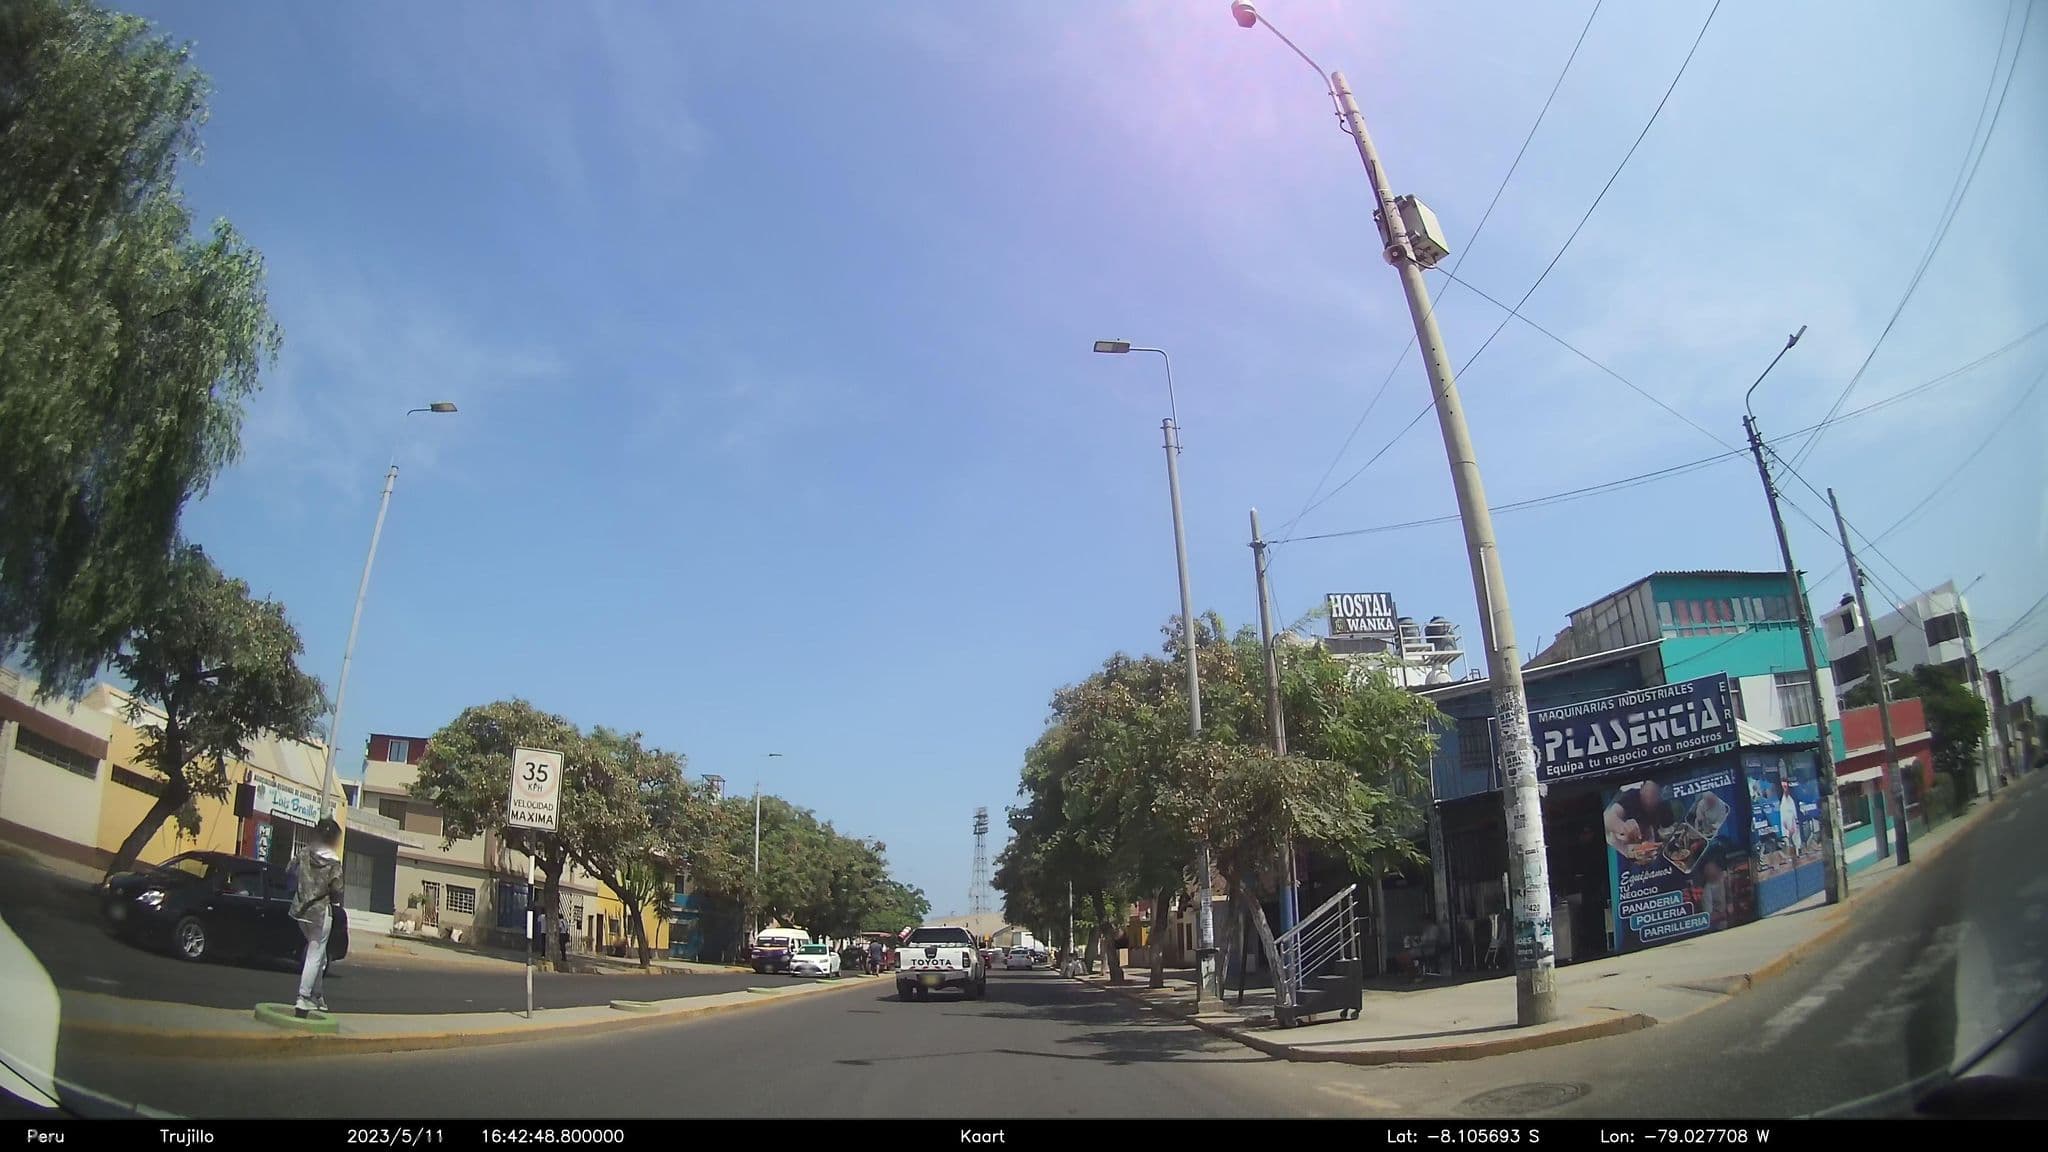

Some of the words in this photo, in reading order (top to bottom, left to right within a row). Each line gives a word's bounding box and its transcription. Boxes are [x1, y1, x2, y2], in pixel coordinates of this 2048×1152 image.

[1329, 593, 1391, 617] HOSTAL
[1346, 618, 1395, 631] WANKA
[1538, 699, 1615, 723] MAQUINARIAS
[1618, 683, 1694, 707] INDUSTRIALES
[1546, 761, 1585, 777] Equipa
[1588, 757, 1601, 769] tu
[1605, 747, 1648, 765] negocio
[1652, 742, 1672, 755] con
[1676, 732, 1722, 750] nosotros
[522, 762, 549, 782] 35
[528, 783, 543, 792] KPH
[513, 799, 554, 811] VELOCIDAD
[511, 810, 554, 825] MAXIMA
[1620, 866, 1673, 886] Equipamos
[1619, 884, 1630, 893] TU
[1620, 886, 1658, 901] NEGOCIO
[1622, 895, 1680, 915] PANADERIA
[1636, 906, 1687, 926] POLLERIA
[1644, 916, 1708, 938] PARRILLERIA
[911, 958, 953, 966] TOYOTA
